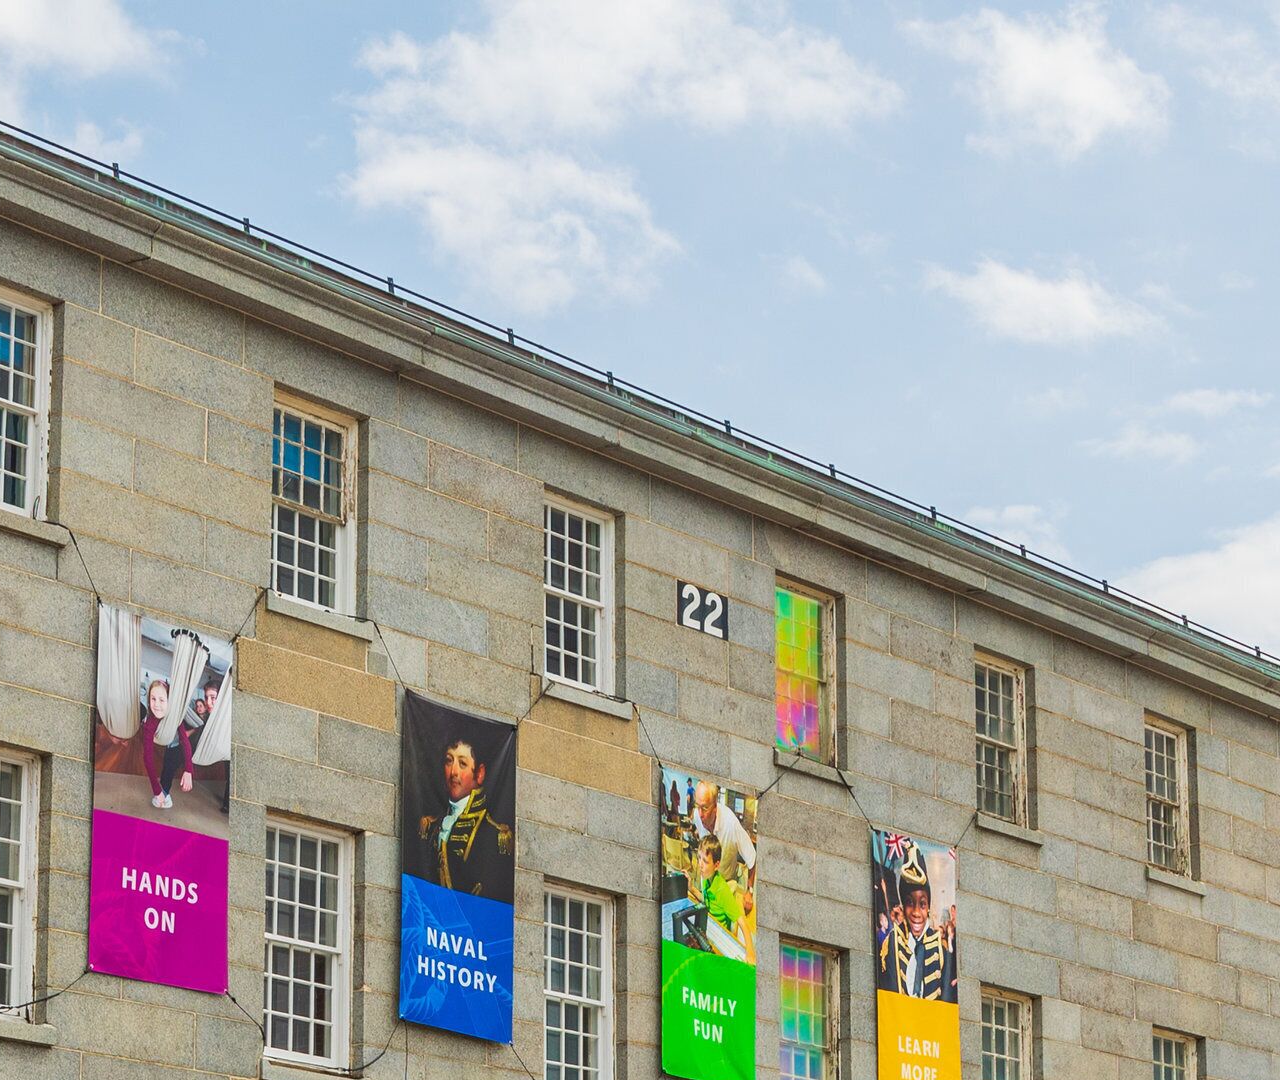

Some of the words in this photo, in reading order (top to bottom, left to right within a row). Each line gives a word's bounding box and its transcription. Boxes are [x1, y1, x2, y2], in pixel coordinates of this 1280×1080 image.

[682, 584, 723, 638] 22
[122, 867, 198, 904] HANDS
[144, 907, 175, 934] ON
[427, 926, 488, 961] NAVAL
[417, 954, 497, 993] HISTORY
[682, 986, 737, 1017] FAMILY
[693, 1018, 723, 1044] FUN
[898, 1035, 940, 1059] LEARN
